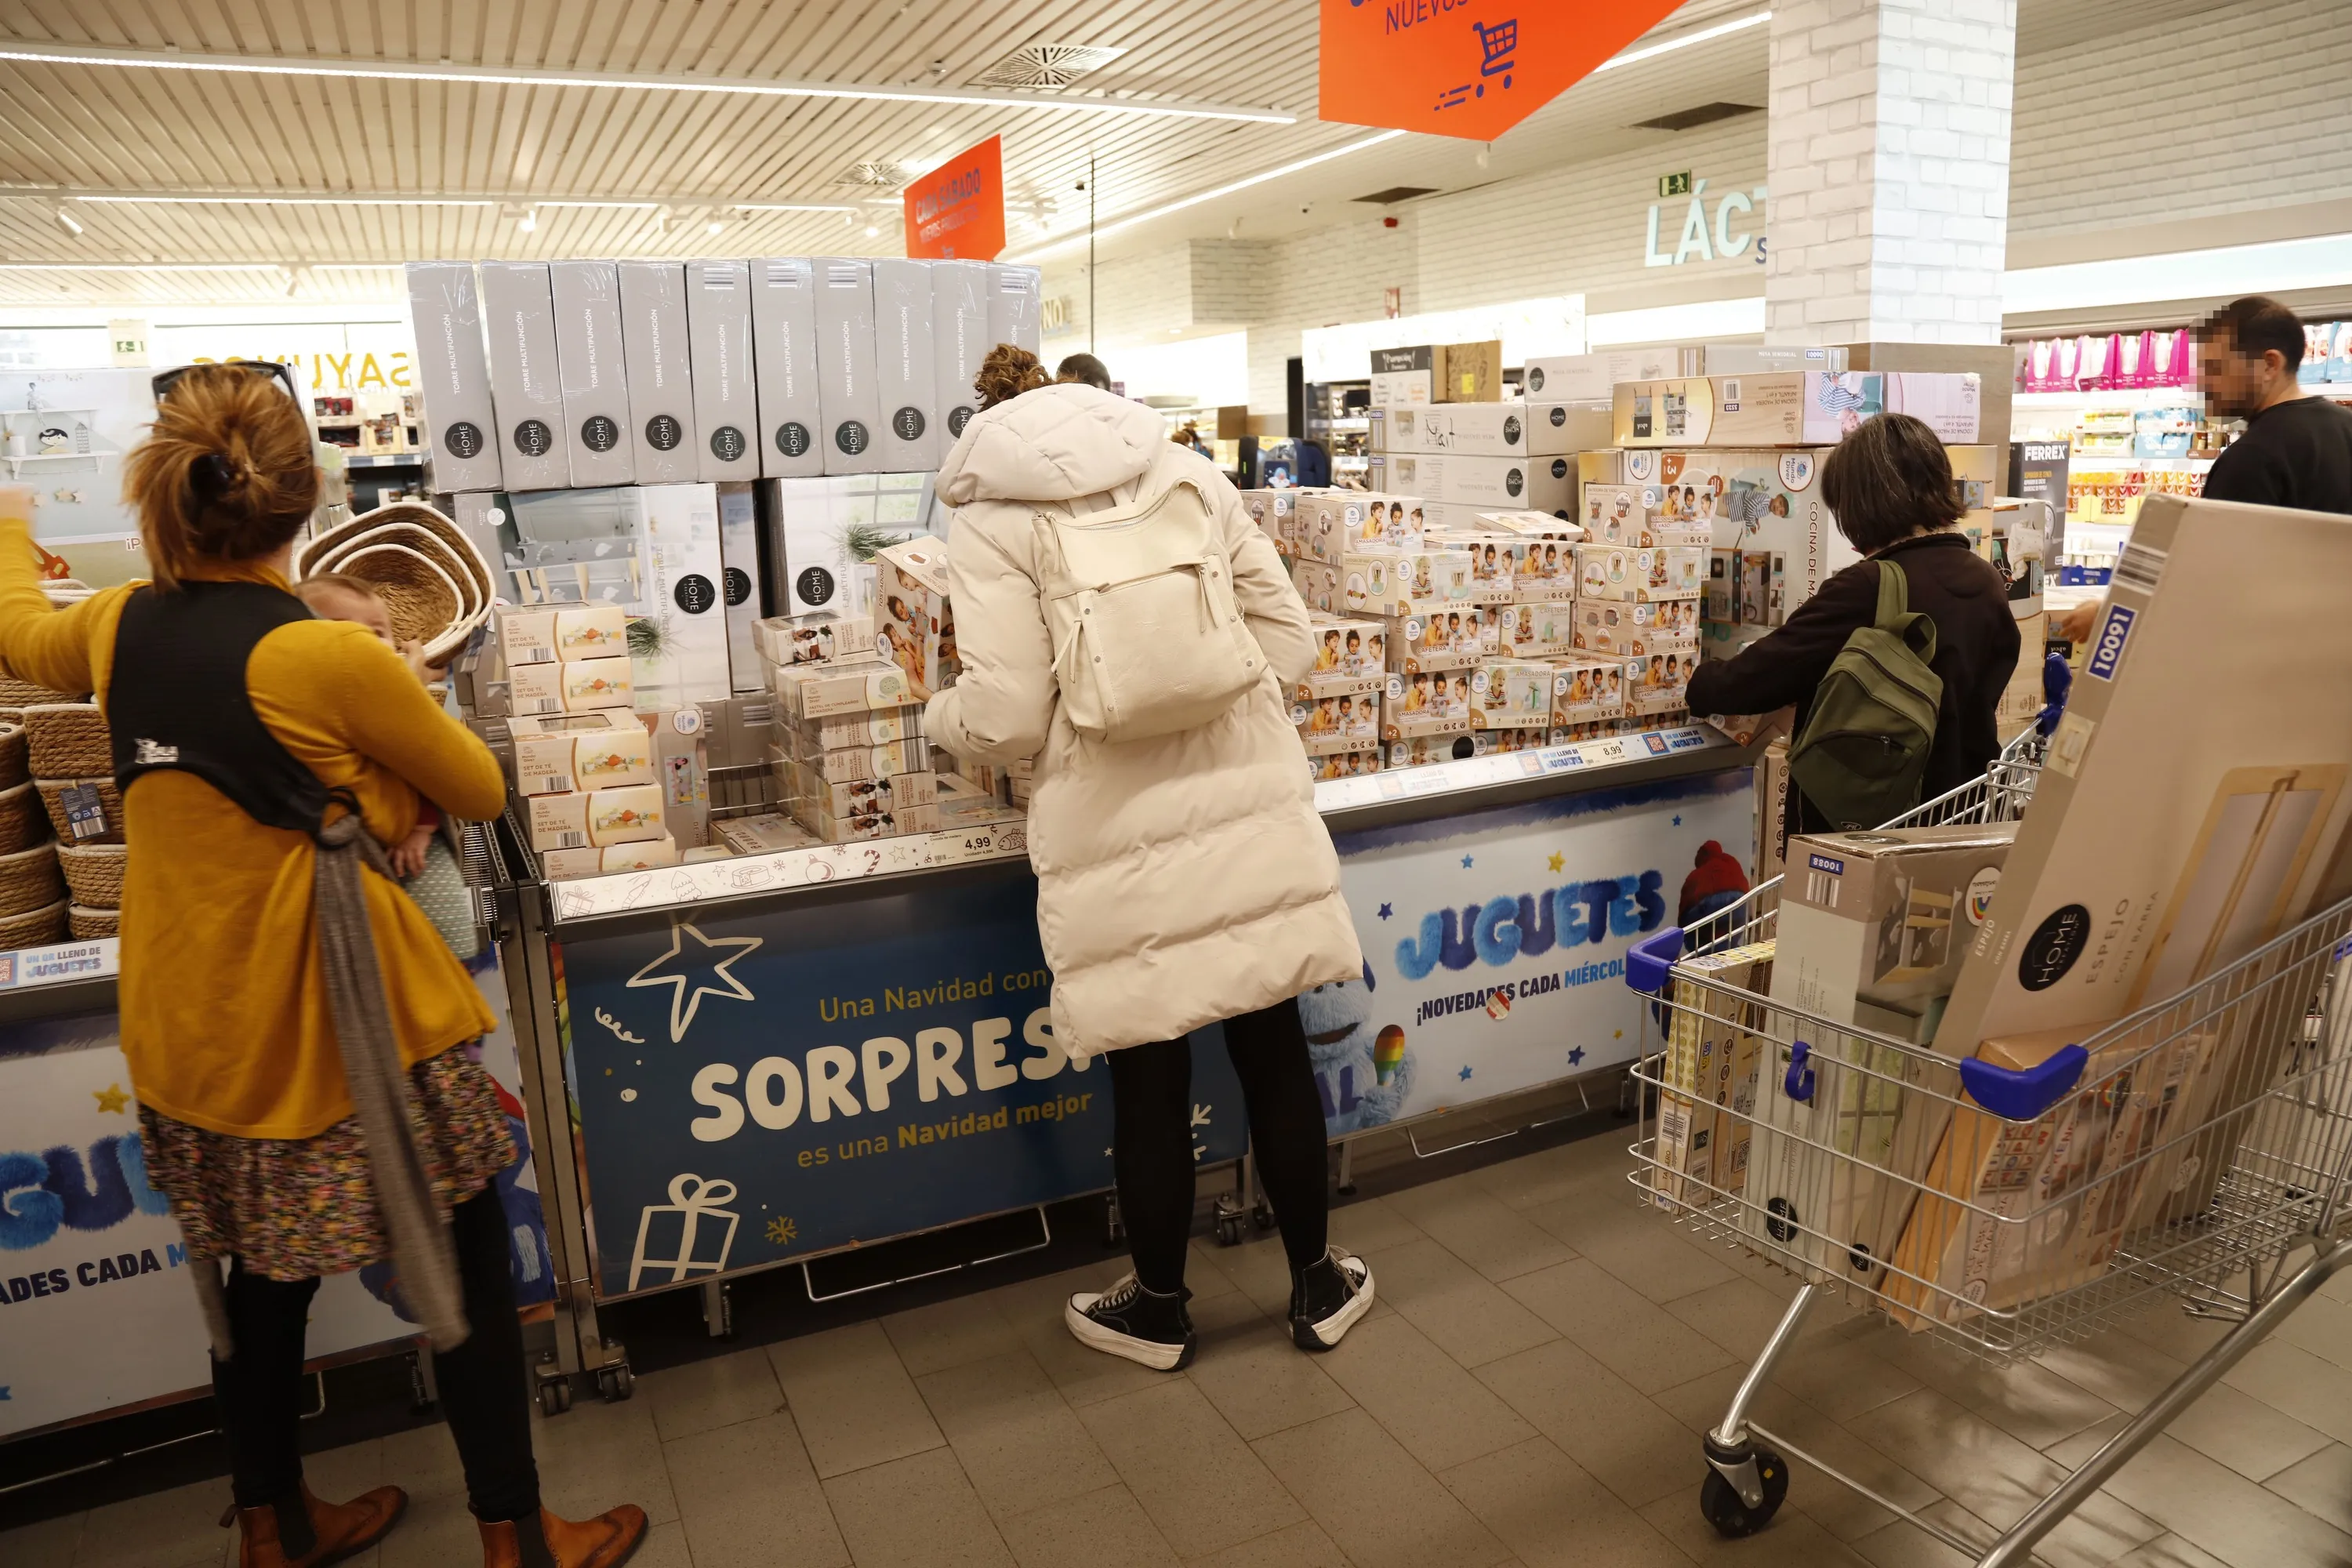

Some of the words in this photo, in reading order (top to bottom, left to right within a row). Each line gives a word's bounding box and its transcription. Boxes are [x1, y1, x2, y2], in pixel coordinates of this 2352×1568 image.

[1385, 0, 1468, 34] NUEVO
[443, 314, 458, 370] MULTIFUNCIÓN
[514, 310, 528, 367] MULTIFUNCIÓN
[584, 309, 597, 364] MULTIFUNCIÓN
[650, 309, 662, 364] MULTIFUNCIÓN
[718, 324, 728, 377] MULTIFUNCIÓN
[782, 321, 793, 375] MULTIFUNCIÓN
[842, 320, 851, 373] MULTIFUNCIÓN
[451, 370, 461, 394] TORRE
[590, 365, 599, 388] TORRE
[529, 423, 540, 455] HOME
[597, 419, 607, 450] HOME
[659, 418, 670, 448] HOME
[789, 425, 799, 454] HOME
[848, 423, 858, 453] HOME
[906, 409, 915, 438] HOME
[459, 424, 472, 456] HOME
[724, 429, 734, 459] HOME
[2024, 445, 2066, 461] FERREX
[1809, 501, 1819, 555] COCINA
[1808, 558, 1817, 576] DE
[688, 578, 699, 611] HOME
[725, 571, 735, 602] HOME
[813, 570, 822, 603] HOME
[2093, 608, 2132, 673] 10091
[1308, 668, 1343, 677] AMASADORA
[1303, 729, 1337, 738] CAFETERA
[1603, 745, 1623, 757] 8,99
[965, 837, 991, 850] 4,99
[1811, 855, 1842, 872] 10088
[1395, 869, 1665, 981] JUGUETES
[1975, 919, 1995, 957] ESPEJO
[2085, 897, 2130, 985] ESPEJO
[57, 949, 87, 960] LLENO
[89, 946, 101, 956] DE
[2037, 911, 2079, 984] HOME
[26, 957, 102, 978] JUGUETES
[1519, 971, 1562, 1001] CADA
[1563, 956, 1625, 989] MIÉRCOL
[819, 994, 876, 1024] Una
[884, 973, 996, 1014] Navidad
[1003, 968, 1048, 993] con
[690, 1006, 1112, 1143] SORPRES
[797, 1145, 829, 1169] es
[837, 1131, 891, 1161] una
[898, 1104, 1009, 1150] Navidad
[1015, 1090, 1094, 1127] mejor
[1662, 1150, 1671, 1181] TAERO
[76, 1247, 163, 1289] CADA
